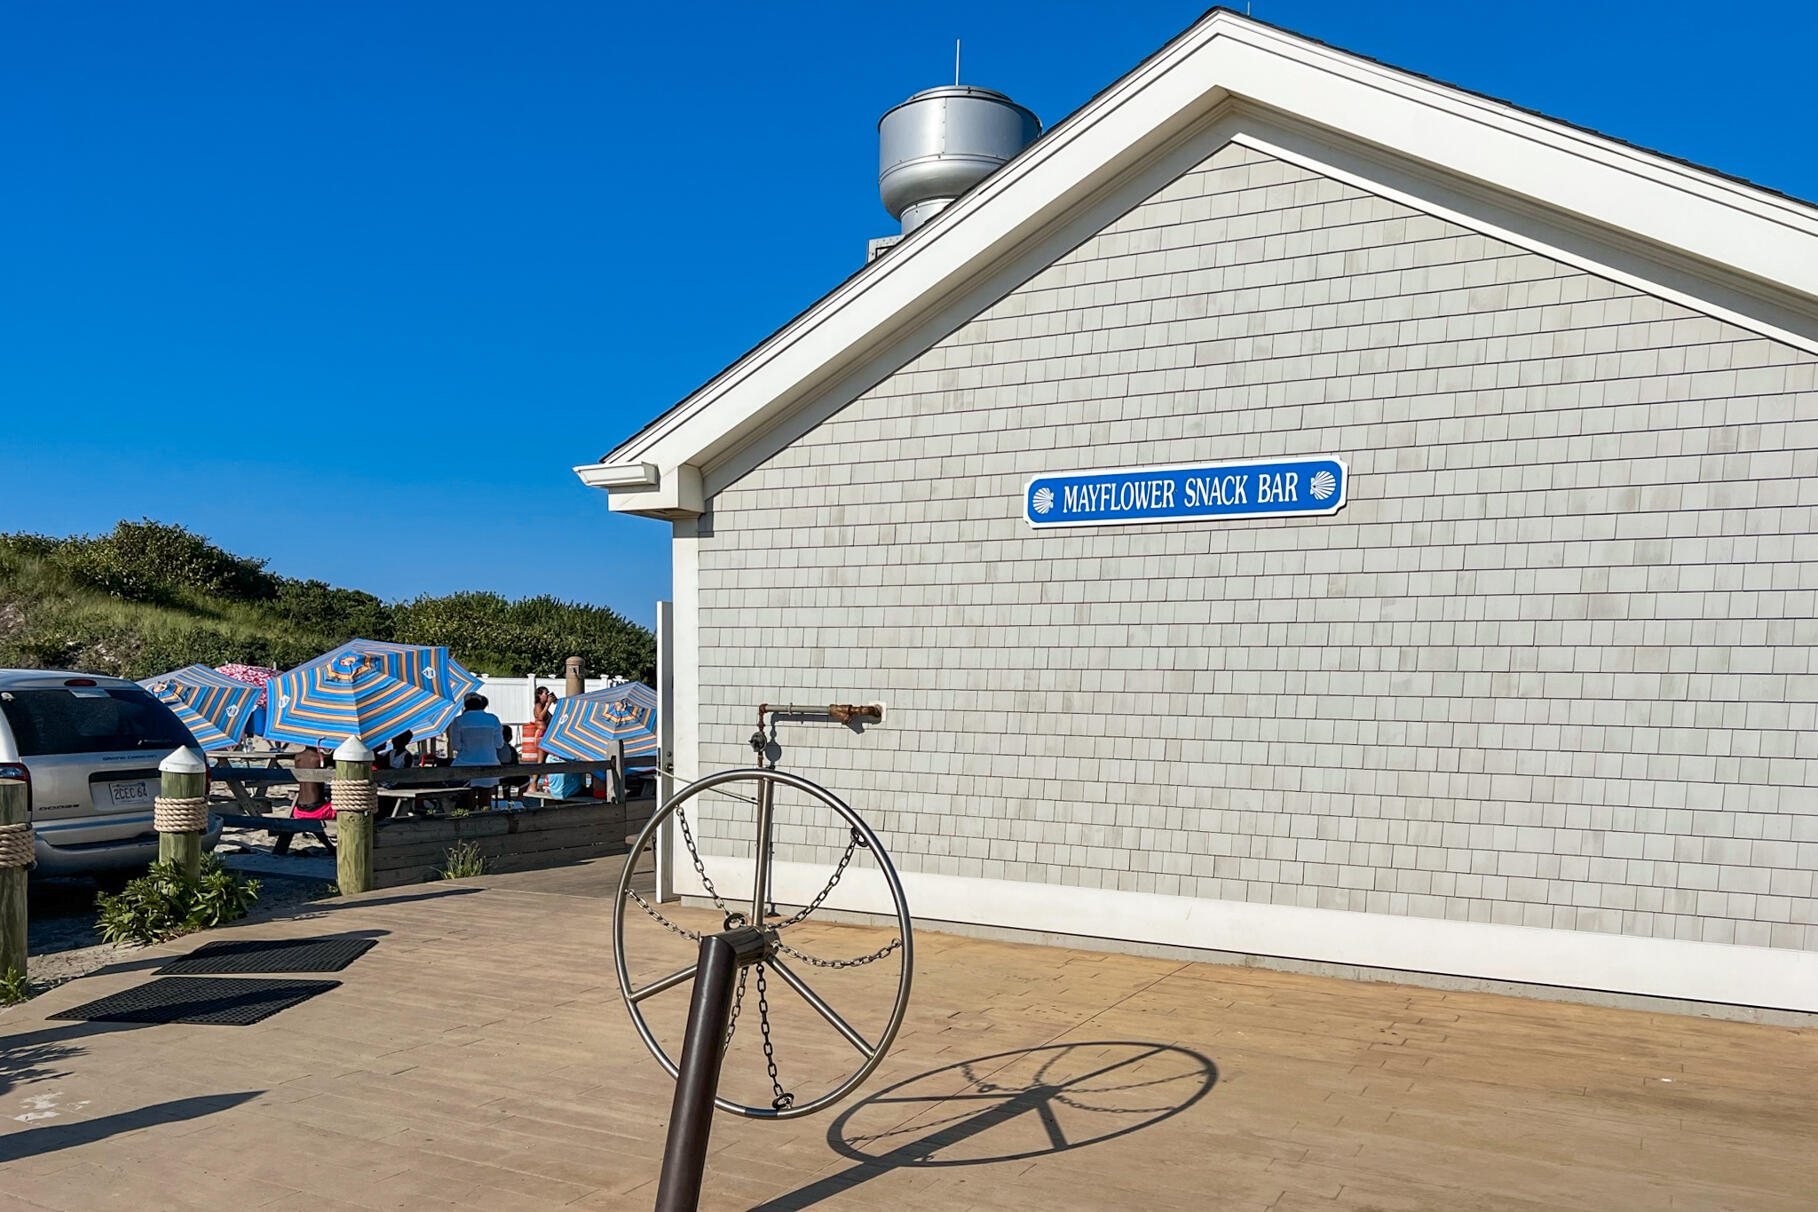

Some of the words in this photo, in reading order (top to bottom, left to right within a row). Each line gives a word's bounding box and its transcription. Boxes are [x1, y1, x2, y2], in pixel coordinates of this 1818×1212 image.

[1062, 479, 1176, 513] MAYFLOWER
[1184, 474, 1249, 508] SNACK
[1257, 472, 1299, 503] BAR
